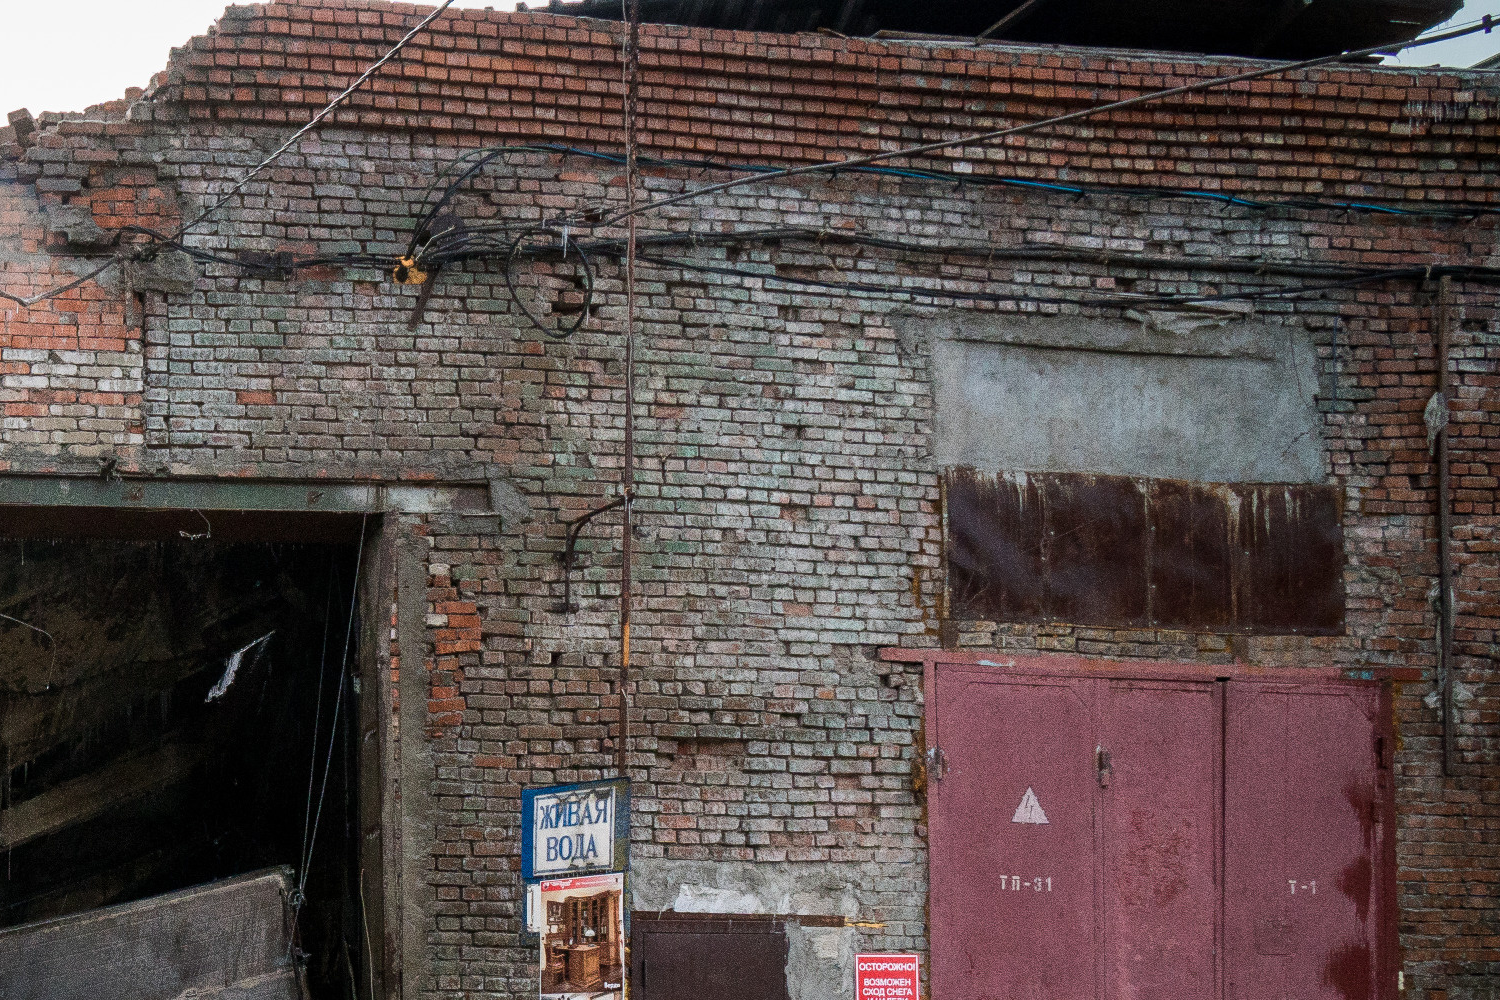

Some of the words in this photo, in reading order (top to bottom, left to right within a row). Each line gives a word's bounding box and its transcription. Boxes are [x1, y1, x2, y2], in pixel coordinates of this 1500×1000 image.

[539, 798, 608, 830] ЖИВАЯ
[546, 833, 598, 862] ВОДА
[999, 874, 1052, 892] ТП-31
[1288, 879, 1316, 895] Т-1
[858, 962, 916, 971] ОСТОРОЖНО!
[863, 978, 911, 986] ВОЗМОЖЕН
[862, 988, 886, 997] СХОД
[886, 988, 913, 996] СНЕГА
